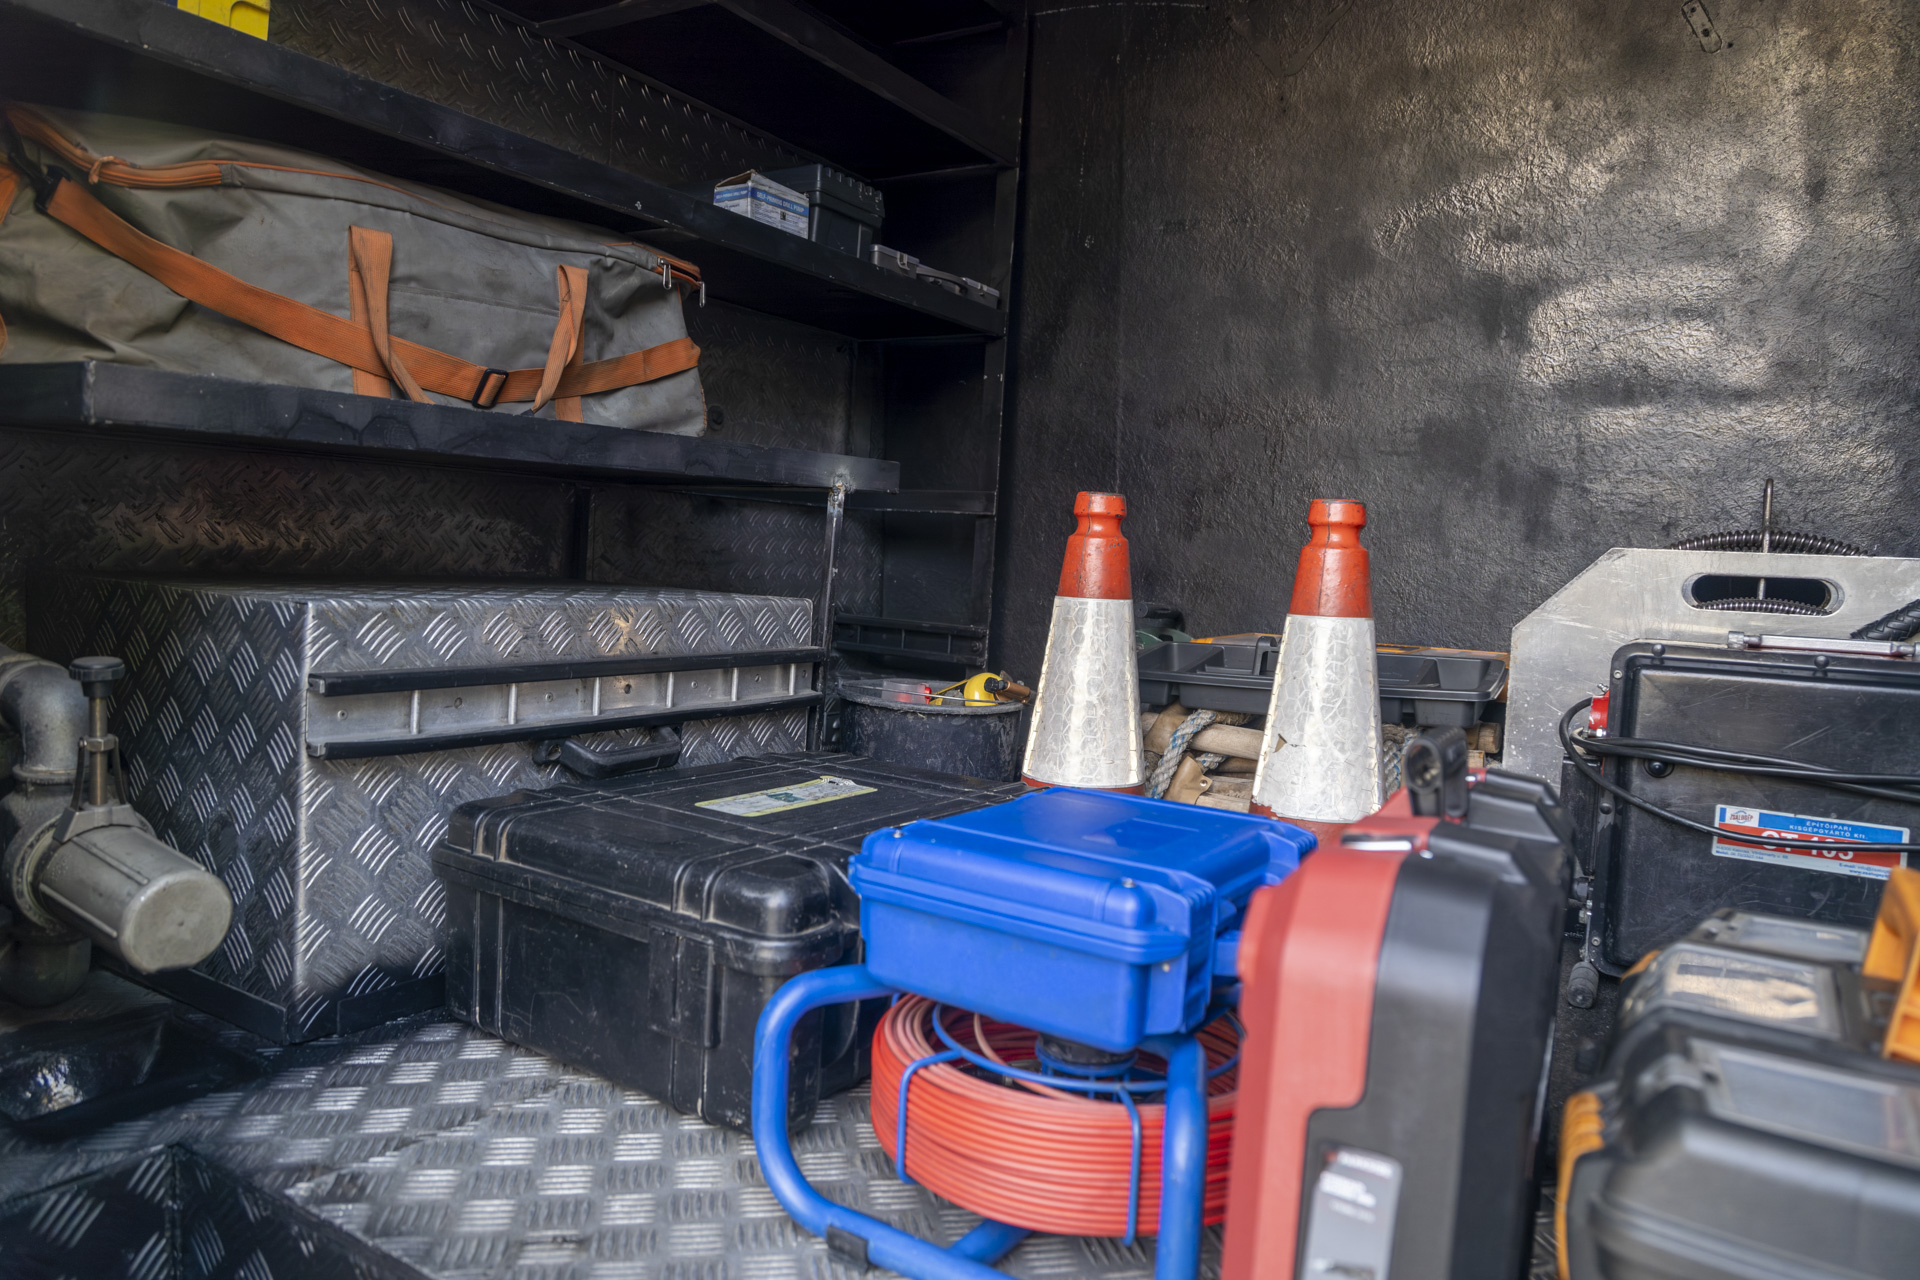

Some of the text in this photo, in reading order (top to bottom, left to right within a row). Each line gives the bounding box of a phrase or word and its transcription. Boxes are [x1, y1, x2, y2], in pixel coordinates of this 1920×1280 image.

[756, 191, 805, 213] SELF-PRIMING DRILL PUMP
